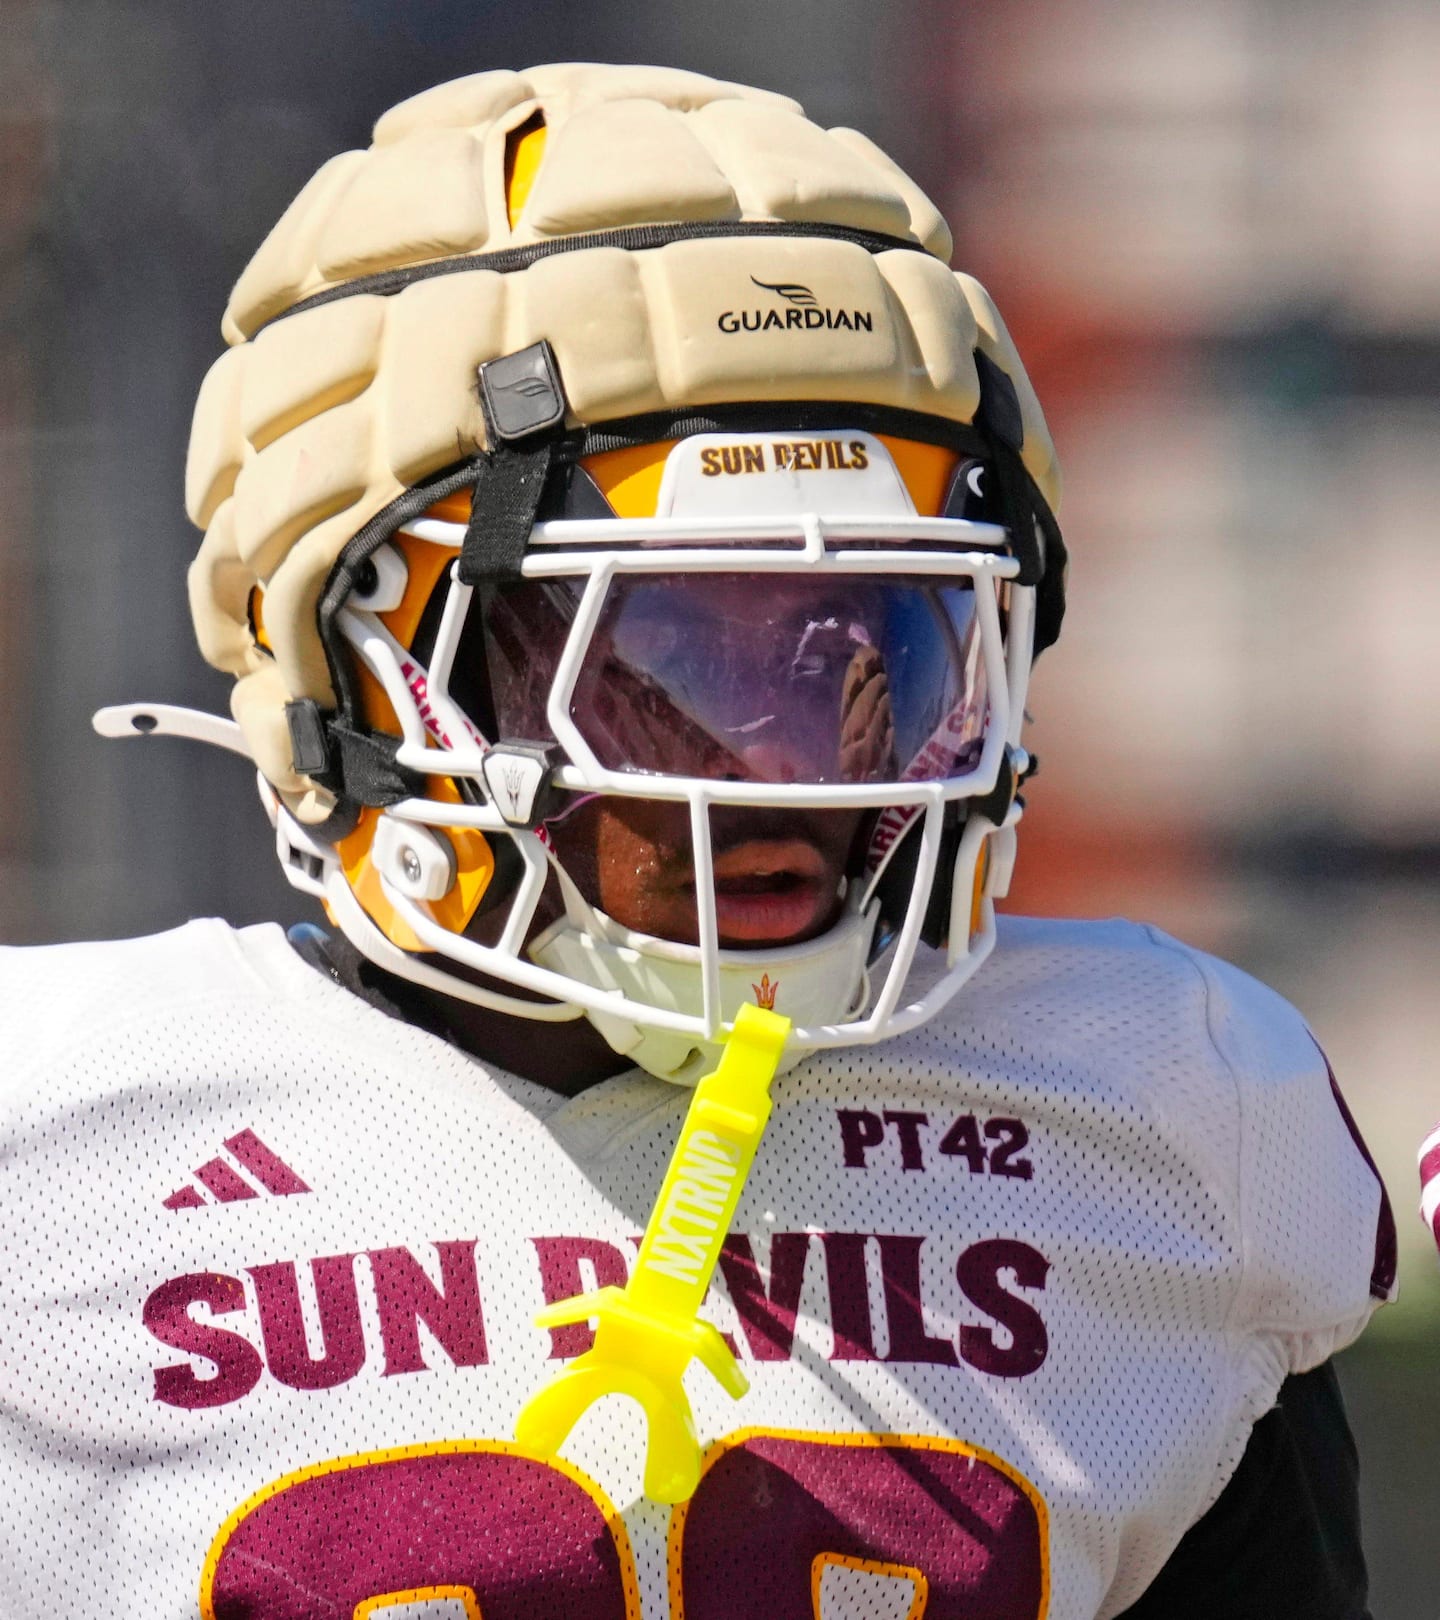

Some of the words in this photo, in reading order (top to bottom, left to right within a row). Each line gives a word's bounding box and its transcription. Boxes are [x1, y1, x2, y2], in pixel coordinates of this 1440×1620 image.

[717, 308, 873, 333] GUARDIAN
[700, 443, 766, 477] SUN
[771, 439, 869, 472] DEVILS
[835, 1108, 930, 1172] PT
[938, 1114, 1034, 1180] 42
[644, 1129, 742, 1286] NXTRND
[141, 1238, 490, 1410] SUN
[527, 1231, 1052, 1378] DVILS
